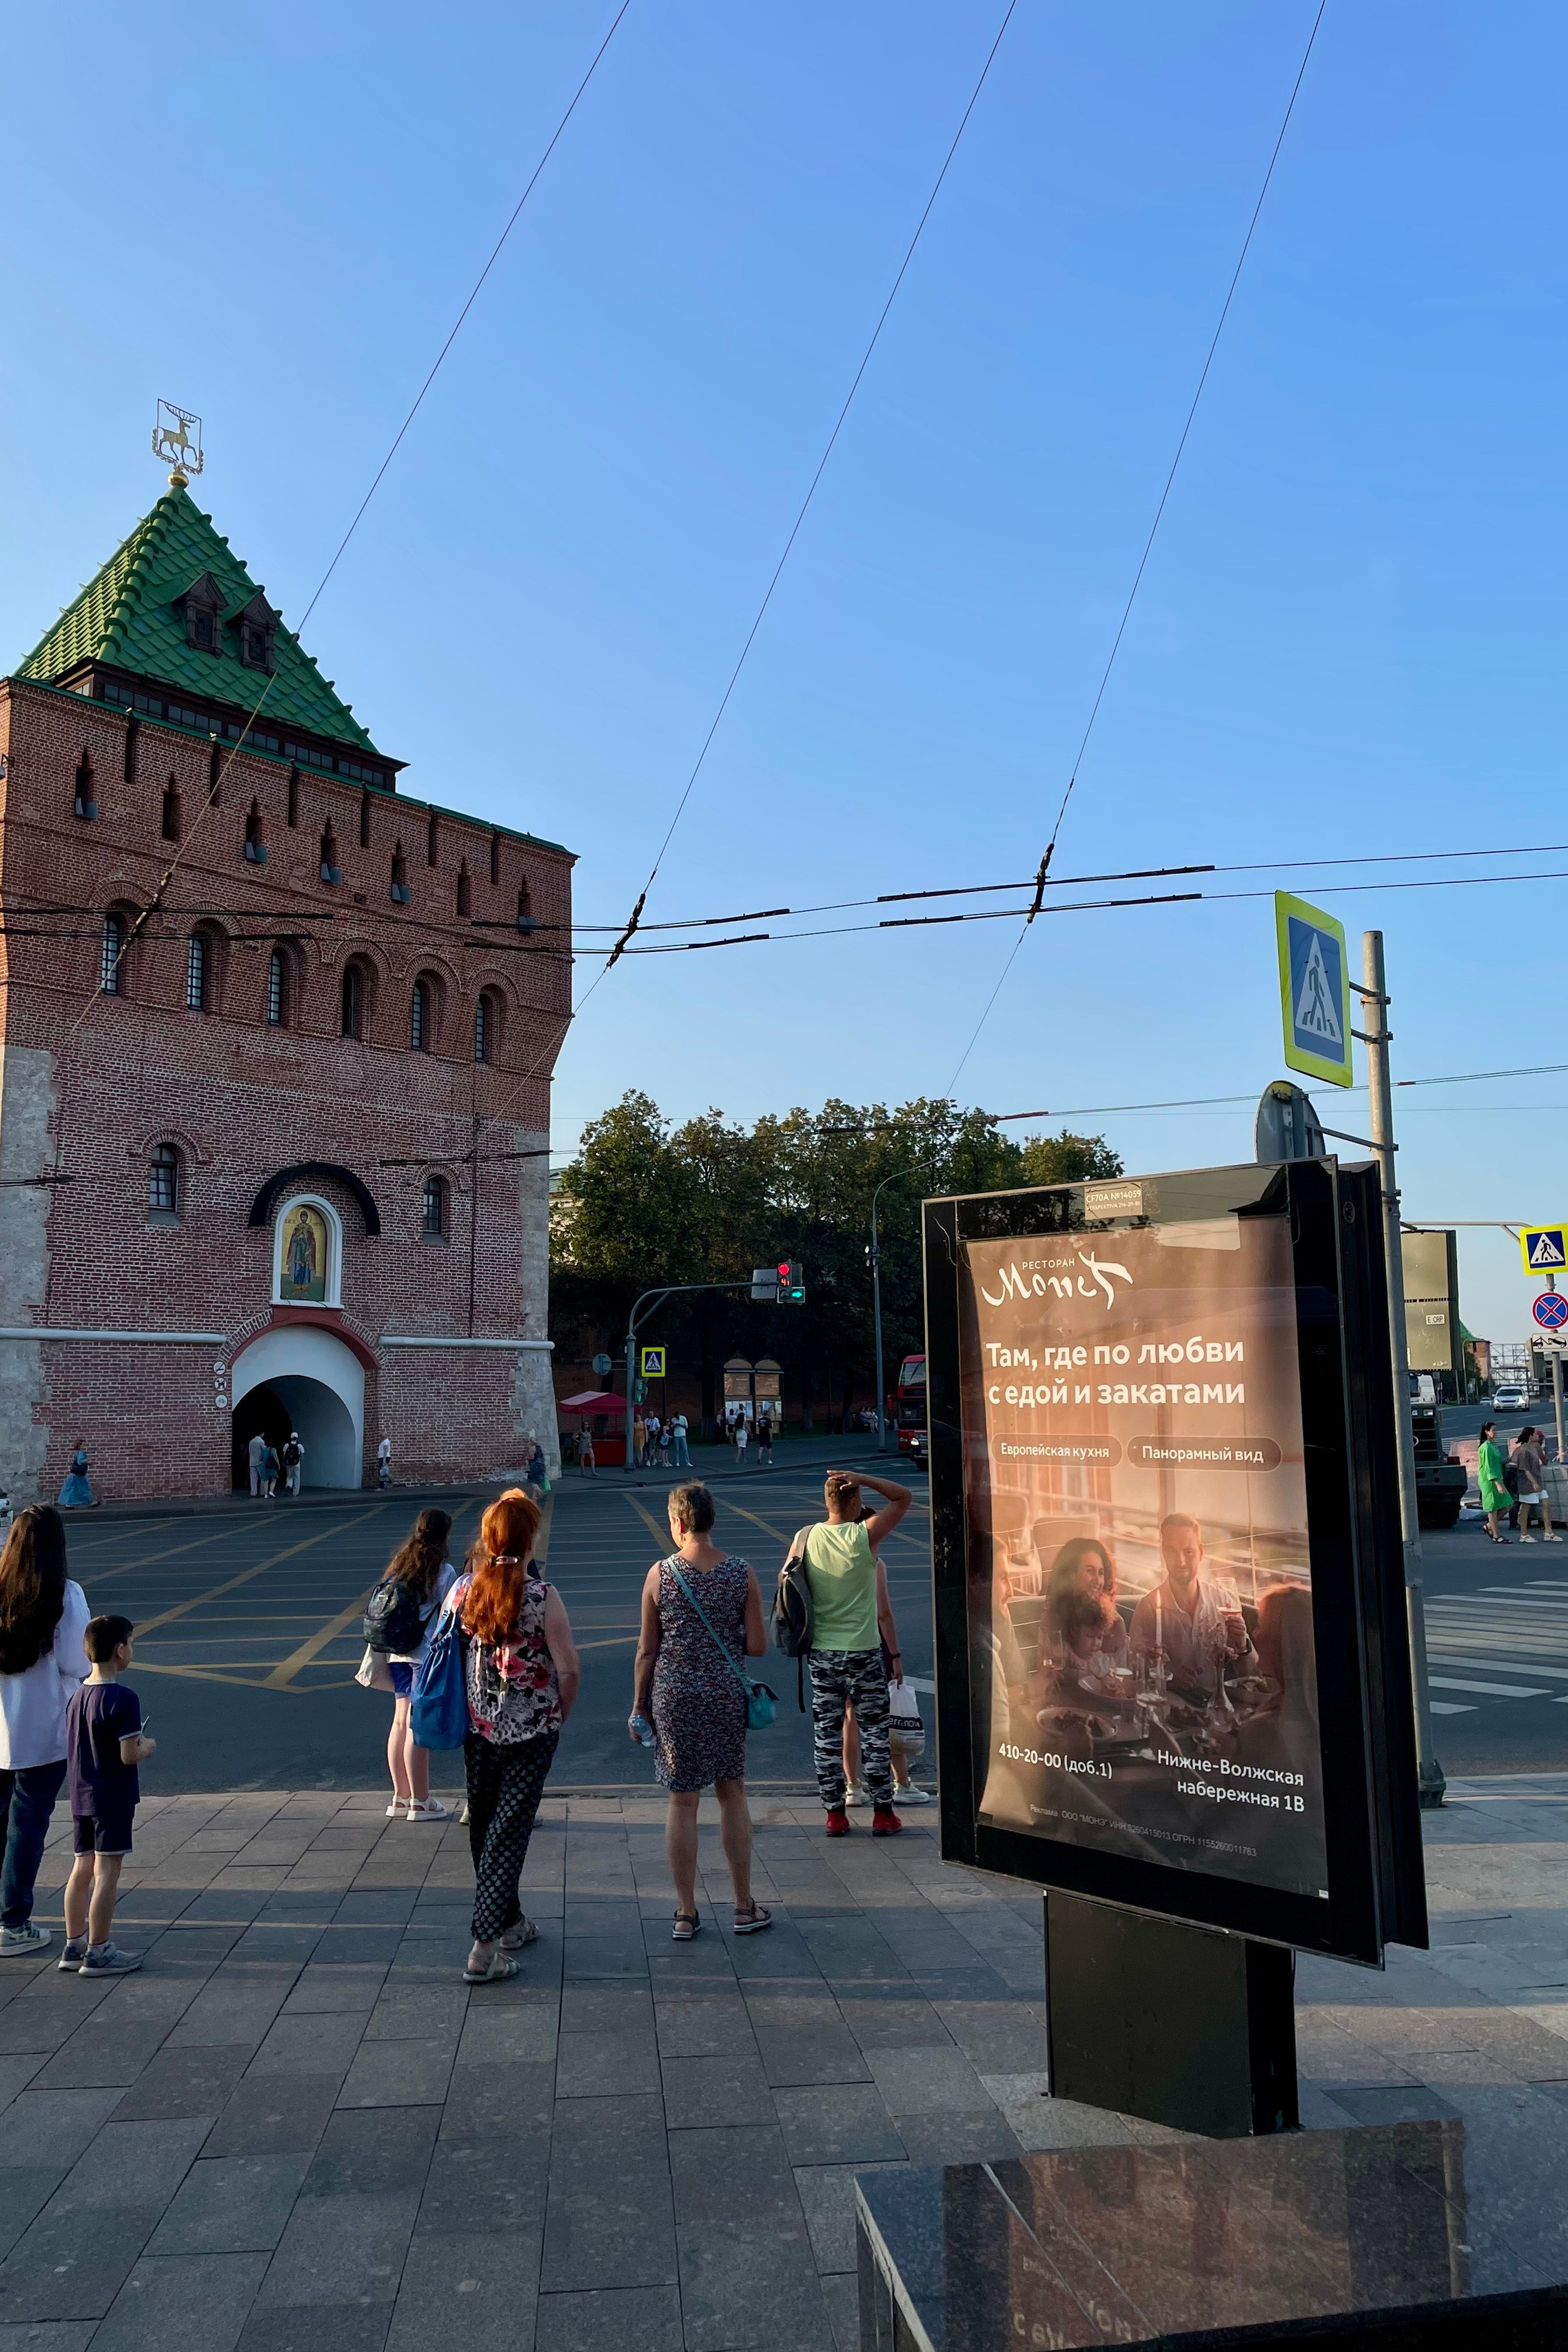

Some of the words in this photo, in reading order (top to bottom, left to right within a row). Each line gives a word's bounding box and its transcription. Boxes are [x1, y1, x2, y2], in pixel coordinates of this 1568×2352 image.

[1111, 1189, 1141, 1200] №14059
[1022, 1257, 1075, 1270] РЕСТОРАН
[986, 1342, 1038, 1371] Там,
[1044, 1346, 1088, 1370] где
[1094, 1344, 1130, 1365] по
[1137, 1335, 1244, 1364] любви
[988, 1385, 1001, 1405] с
[1005, 1377, 1068, 1408] едой
[1075, 1385, 1090, 1404] и
[1097, 1383, 1245, 1405] закатами
[1001, 1442, 1070, 1458] Европейская
[1072, 1448, 1110, 1461] кухня
[1142, 1446, 1232, 1463] Панорамный
[1234, 1450, 1264, 1463] вид
[999, 1743, 1061, 1768] 410-20-00
[1064, 1755, 1112, 1779] (доб.1)
[1157, 1749, 1304, 1786] Нижне-Волжская
[1177, 1781, 1279, 1808] набережная
[1283, 1795, 1305, 1812] 1В
[1061, 1810, 1079, 1821] ООО
[1110, 1820, 1126, 1831] ИНН
[1172, 1833, 1195, 1845] ОГРН
